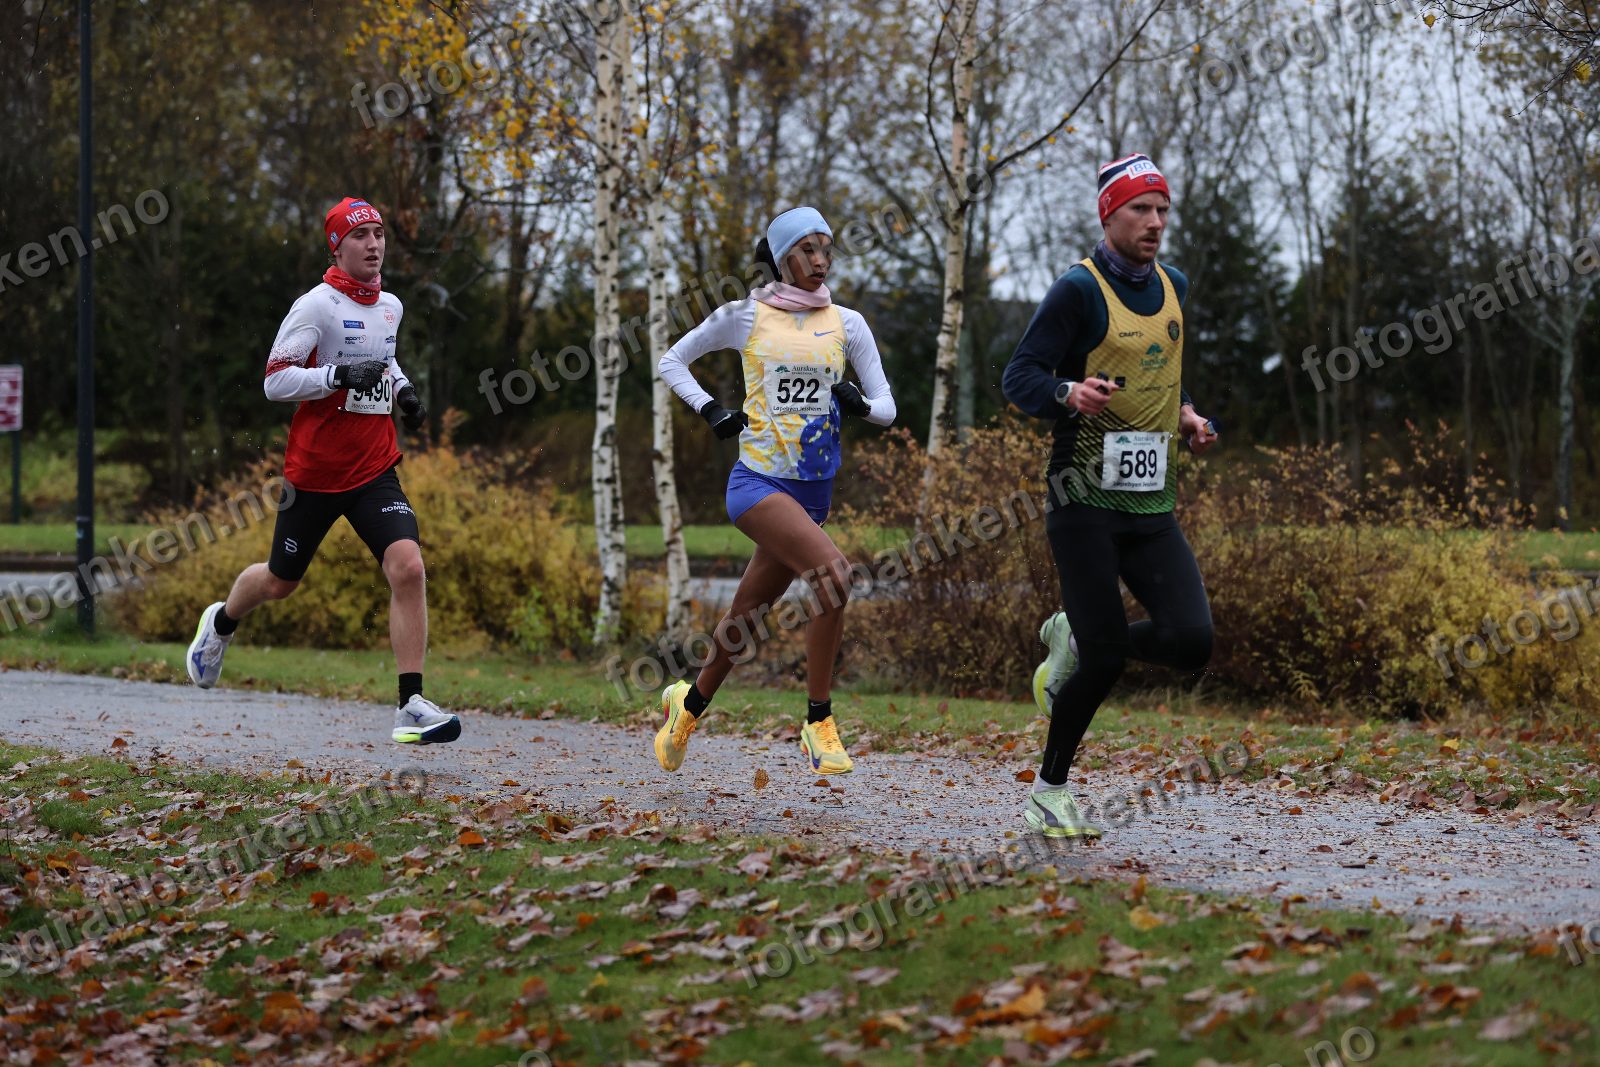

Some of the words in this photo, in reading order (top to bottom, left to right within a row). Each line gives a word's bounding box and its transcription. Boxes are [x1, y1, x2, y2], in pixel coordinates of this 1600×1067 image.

[346, 208, 370, 226] NES
[791, 365, 818, 373] Aurskog
[777, 378, 820, 404] 522
[1119, 449, 1157, 478] 589
